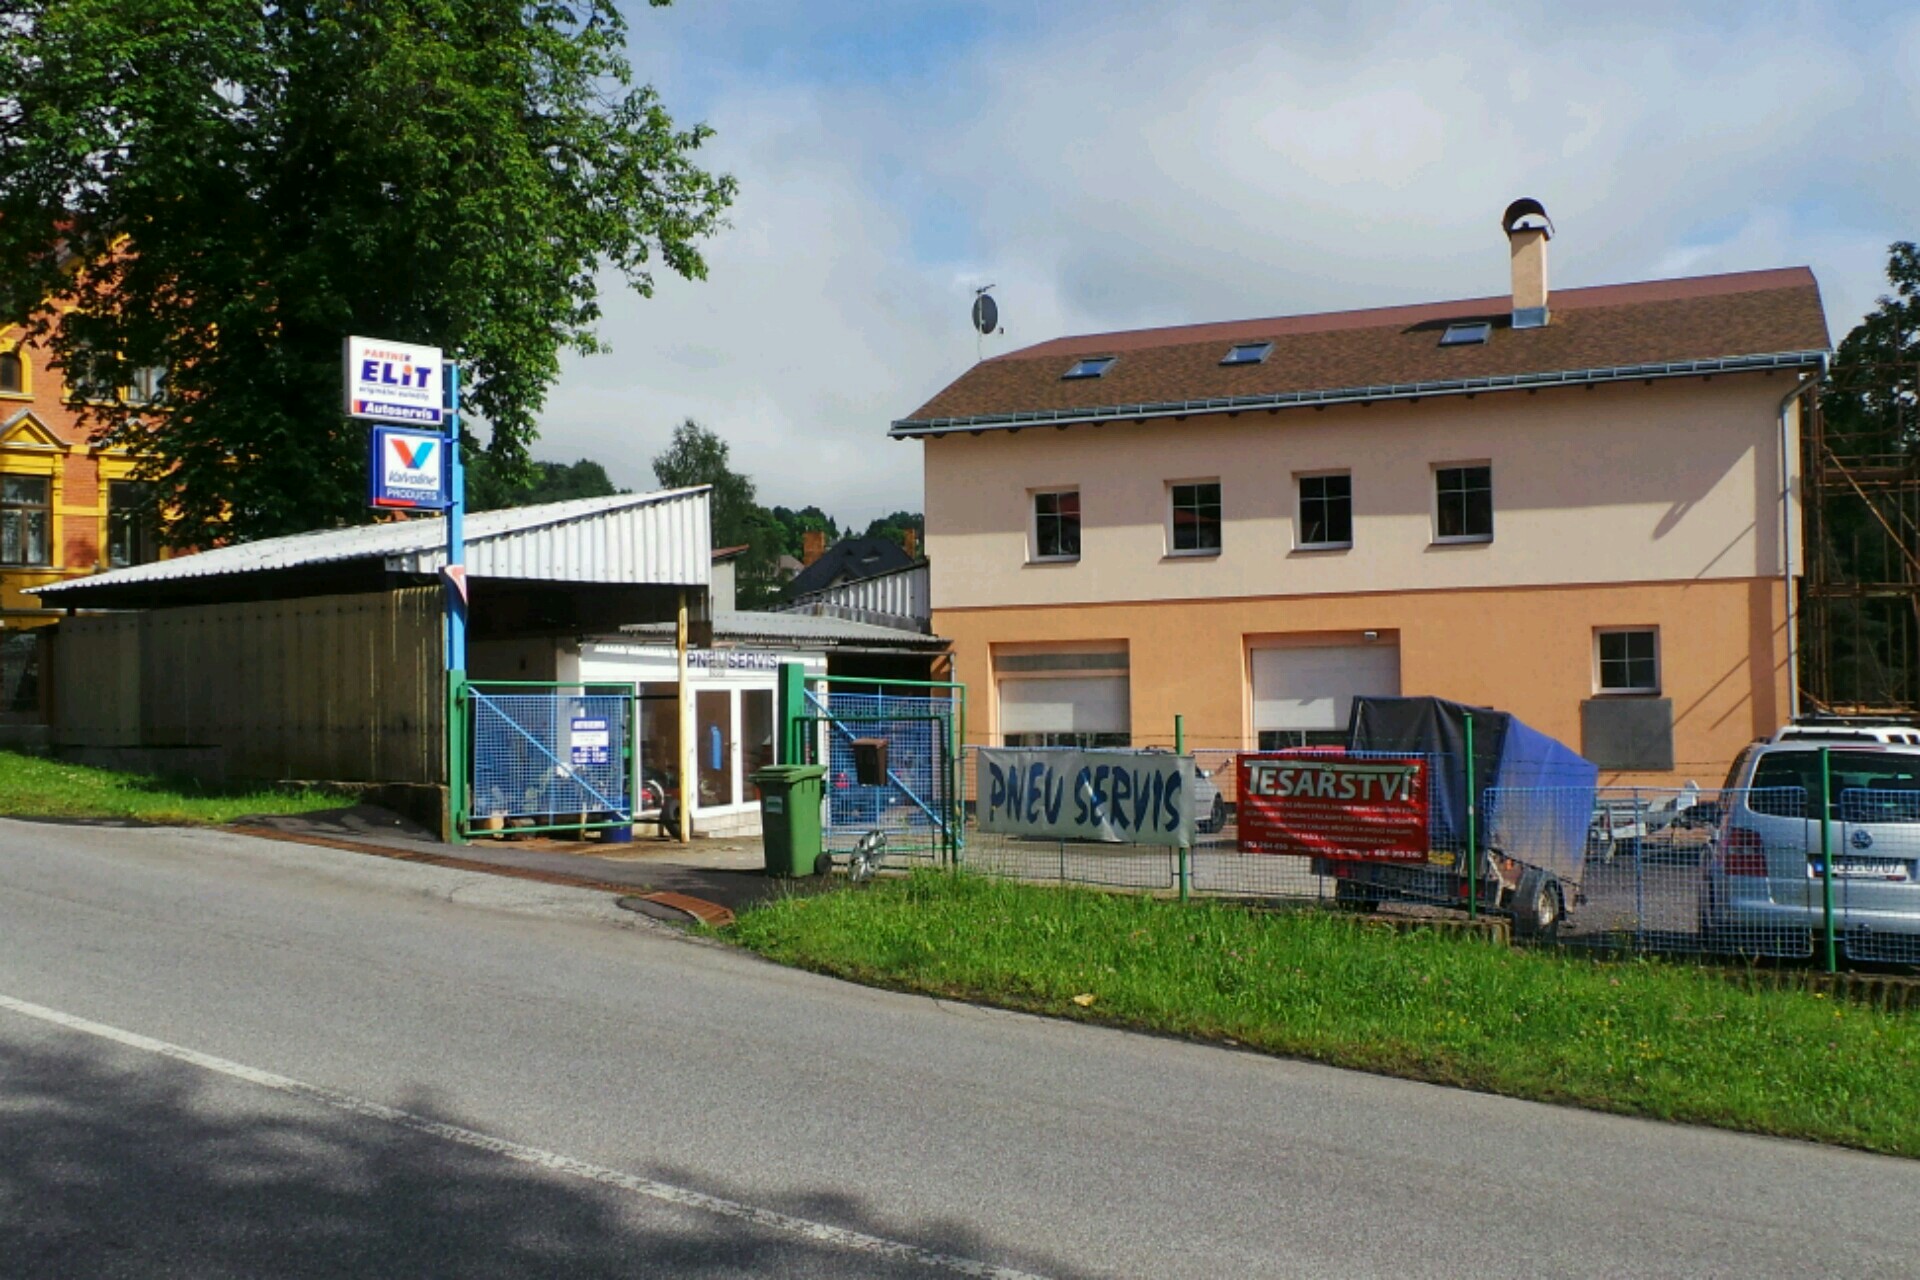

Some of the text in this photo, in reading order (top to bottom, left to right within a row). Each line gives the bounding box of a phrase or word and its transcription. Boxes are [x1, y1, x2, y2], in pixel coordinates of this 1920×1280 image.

[363, 348, 412, 361] PARTNER
[364, 402, 434, 420] Autoservis
[386, 487, 438, 501] PRODUCTS
[728, 653, 778, 669] SERVIS
[989, 761, 1183, 834] PNEU SERVIS
